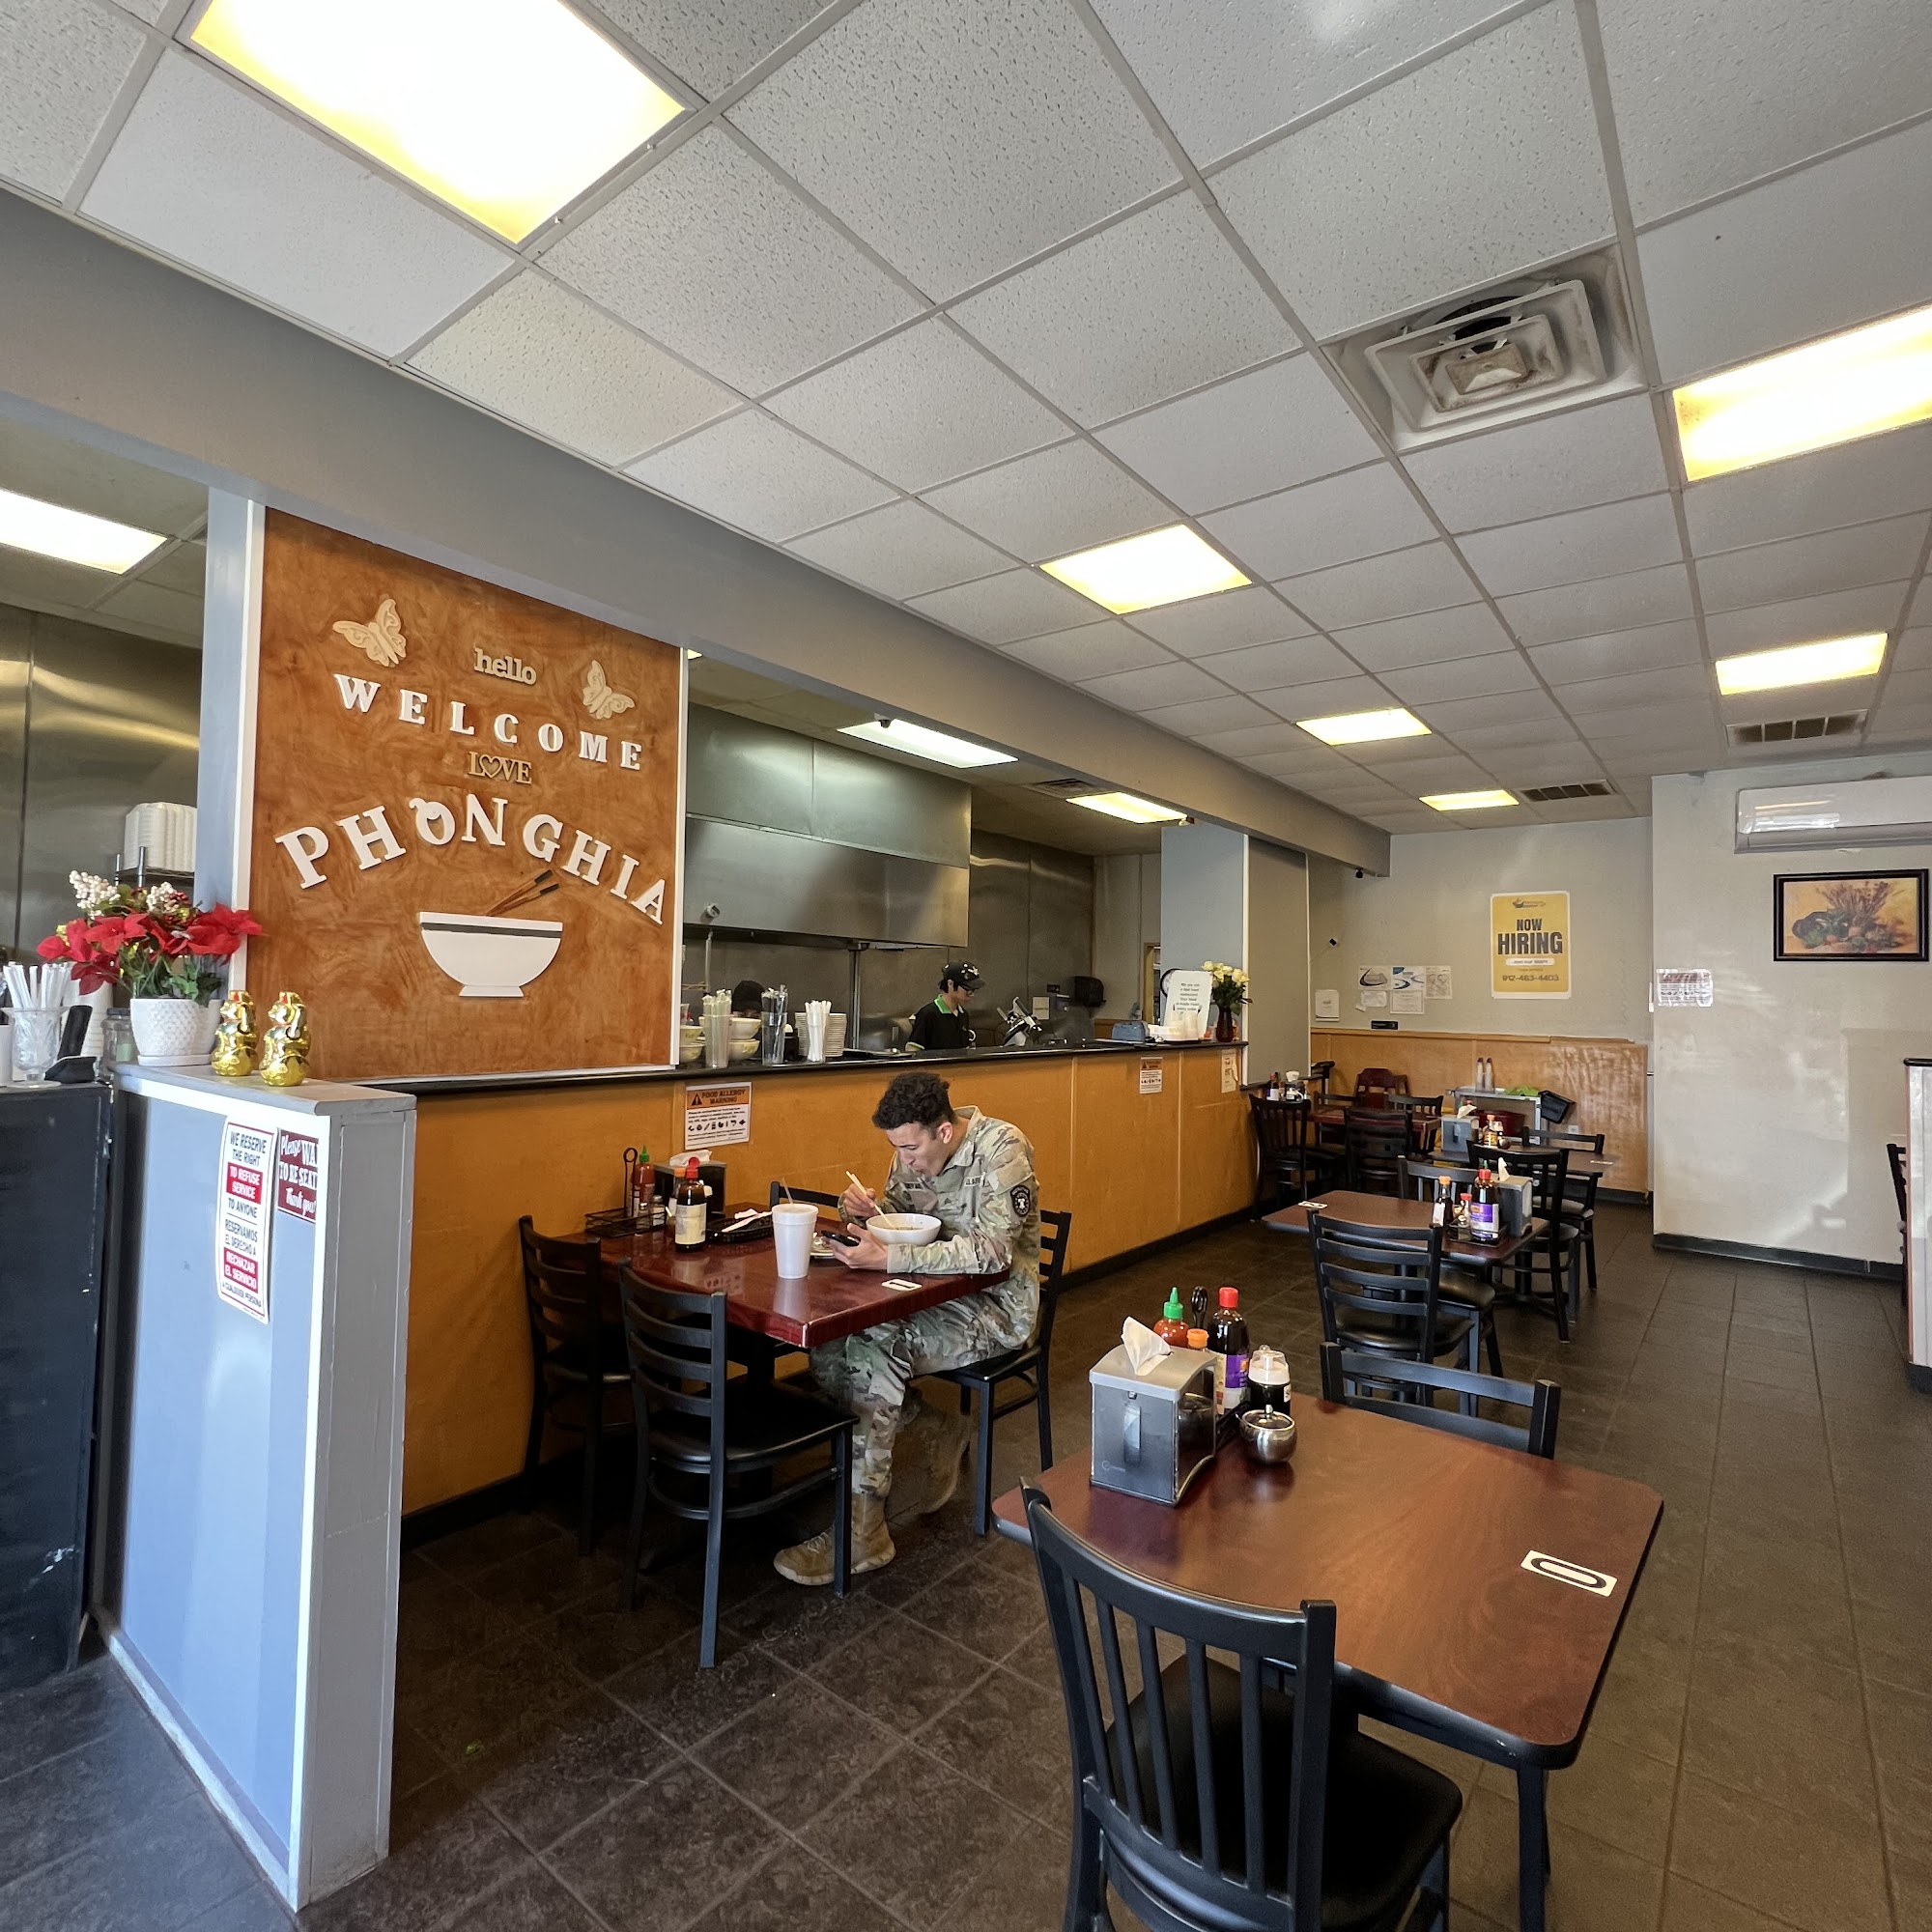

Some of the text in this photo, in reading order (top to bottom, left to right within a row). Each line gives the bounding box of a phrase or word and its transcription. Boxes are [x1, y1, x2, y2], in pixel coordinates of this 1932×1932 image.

[473, 647, 537, 685] hello
[333, 673, 642, 771] WELCOME
[1517, 919, 1543, 931] NOW
[1497, 932, 1563, 954] HIRING
[230, 1131, 267, 1153] WE RESERVE
[281, 1135, 301, 1157] Please
[233, 1149, 261, 1166] THE RIGHT
[230, 1166, 260, 1186] TO REFUSE
[279, 1161, 289, 1180] TO
[289, 1164, 298, 1183] BE
[232, 1180, 256, 1199] SERVICE
[229, 1197, 258, 1218] TO ANYONE
[225, 1218, 258, 1242] RESERVAMOS
[232, 1267, 256, 1290] SERVICIO
